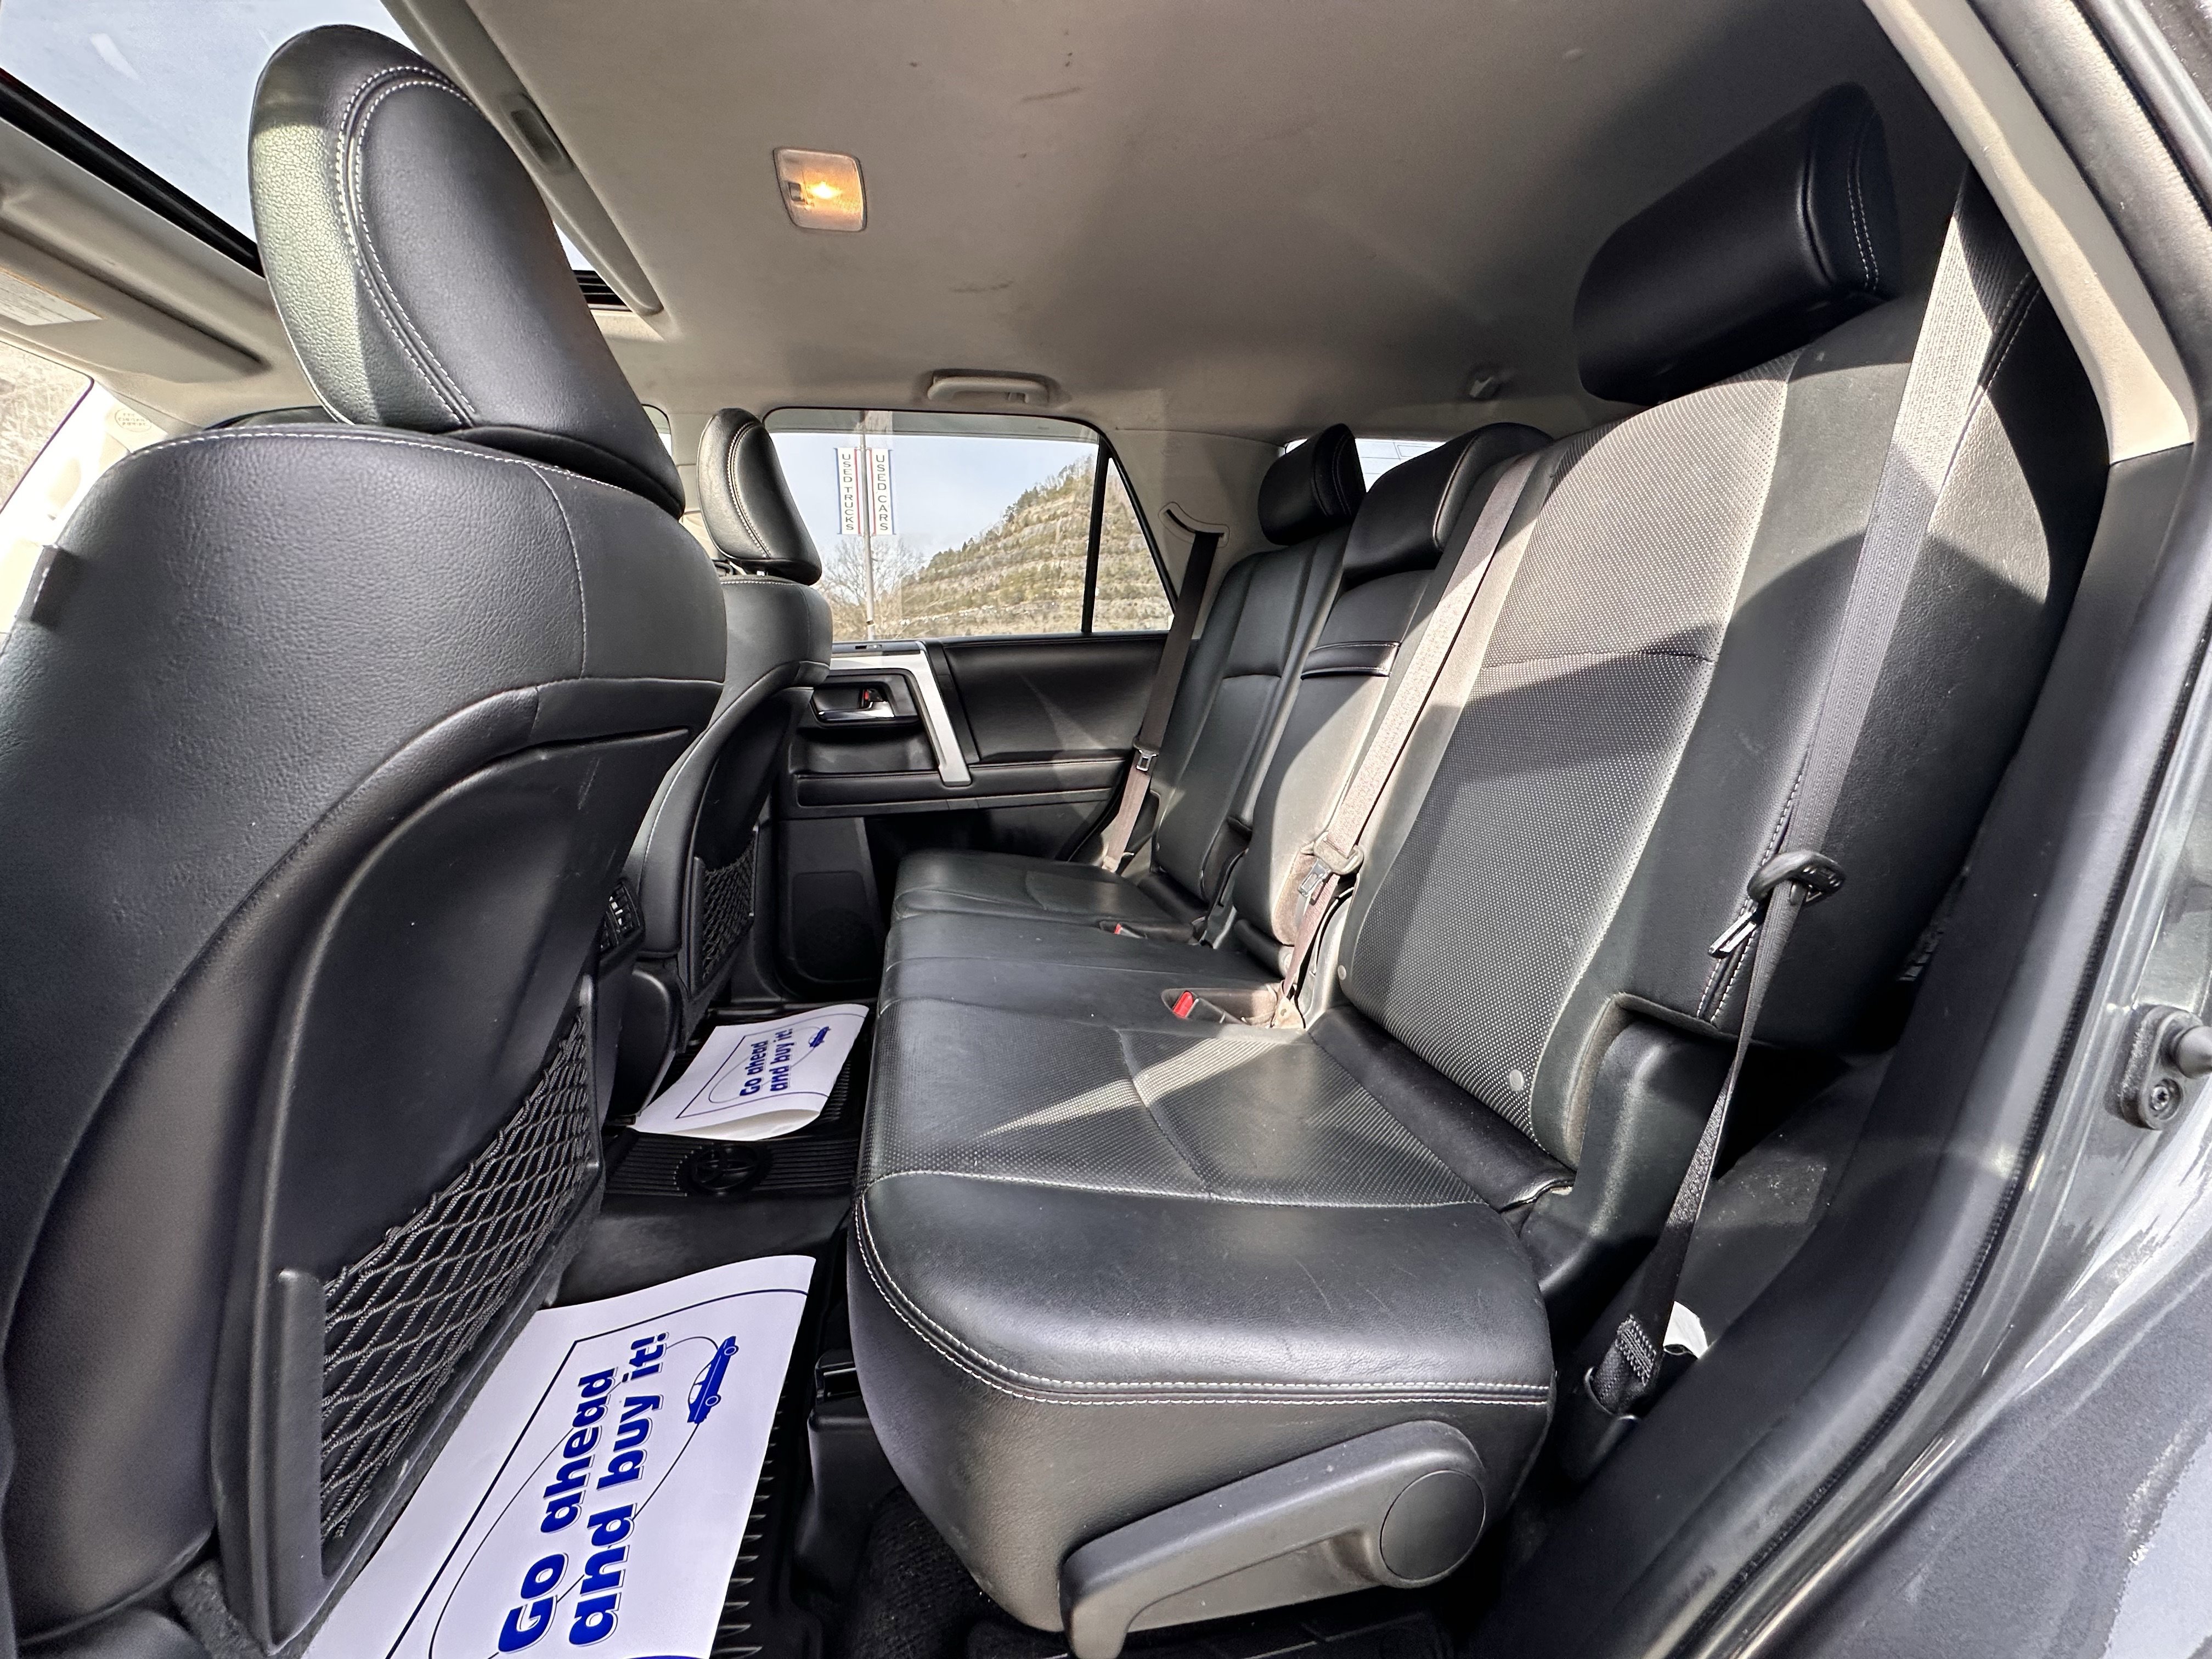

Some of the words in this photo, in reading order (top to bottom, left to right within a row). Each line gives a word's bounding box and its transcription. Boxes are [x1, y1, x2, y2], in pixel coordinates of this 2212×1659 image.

[842, 454, 853, 482] USED
[876, 455, 887, 490] USED
[844, 487, 854, 531] TRUCKS
[878, 495, 888, 531] CARS
[773, 1028, 793, 1042] it!
[744, 1040, 769, 1075] ahead
[770, 1042, 795, 1064] buy
[740, 1077, 763, 1096] Go
[769, 1065, 790, 1091] and
[622, 1331, 669, 1383] it!
[596, 1394, 664, 1490] buy
[498, 1553, 569, 1654] Go
[540, 1367, 618, 1534] ahead
[569, 1503, 637, 1647] and
